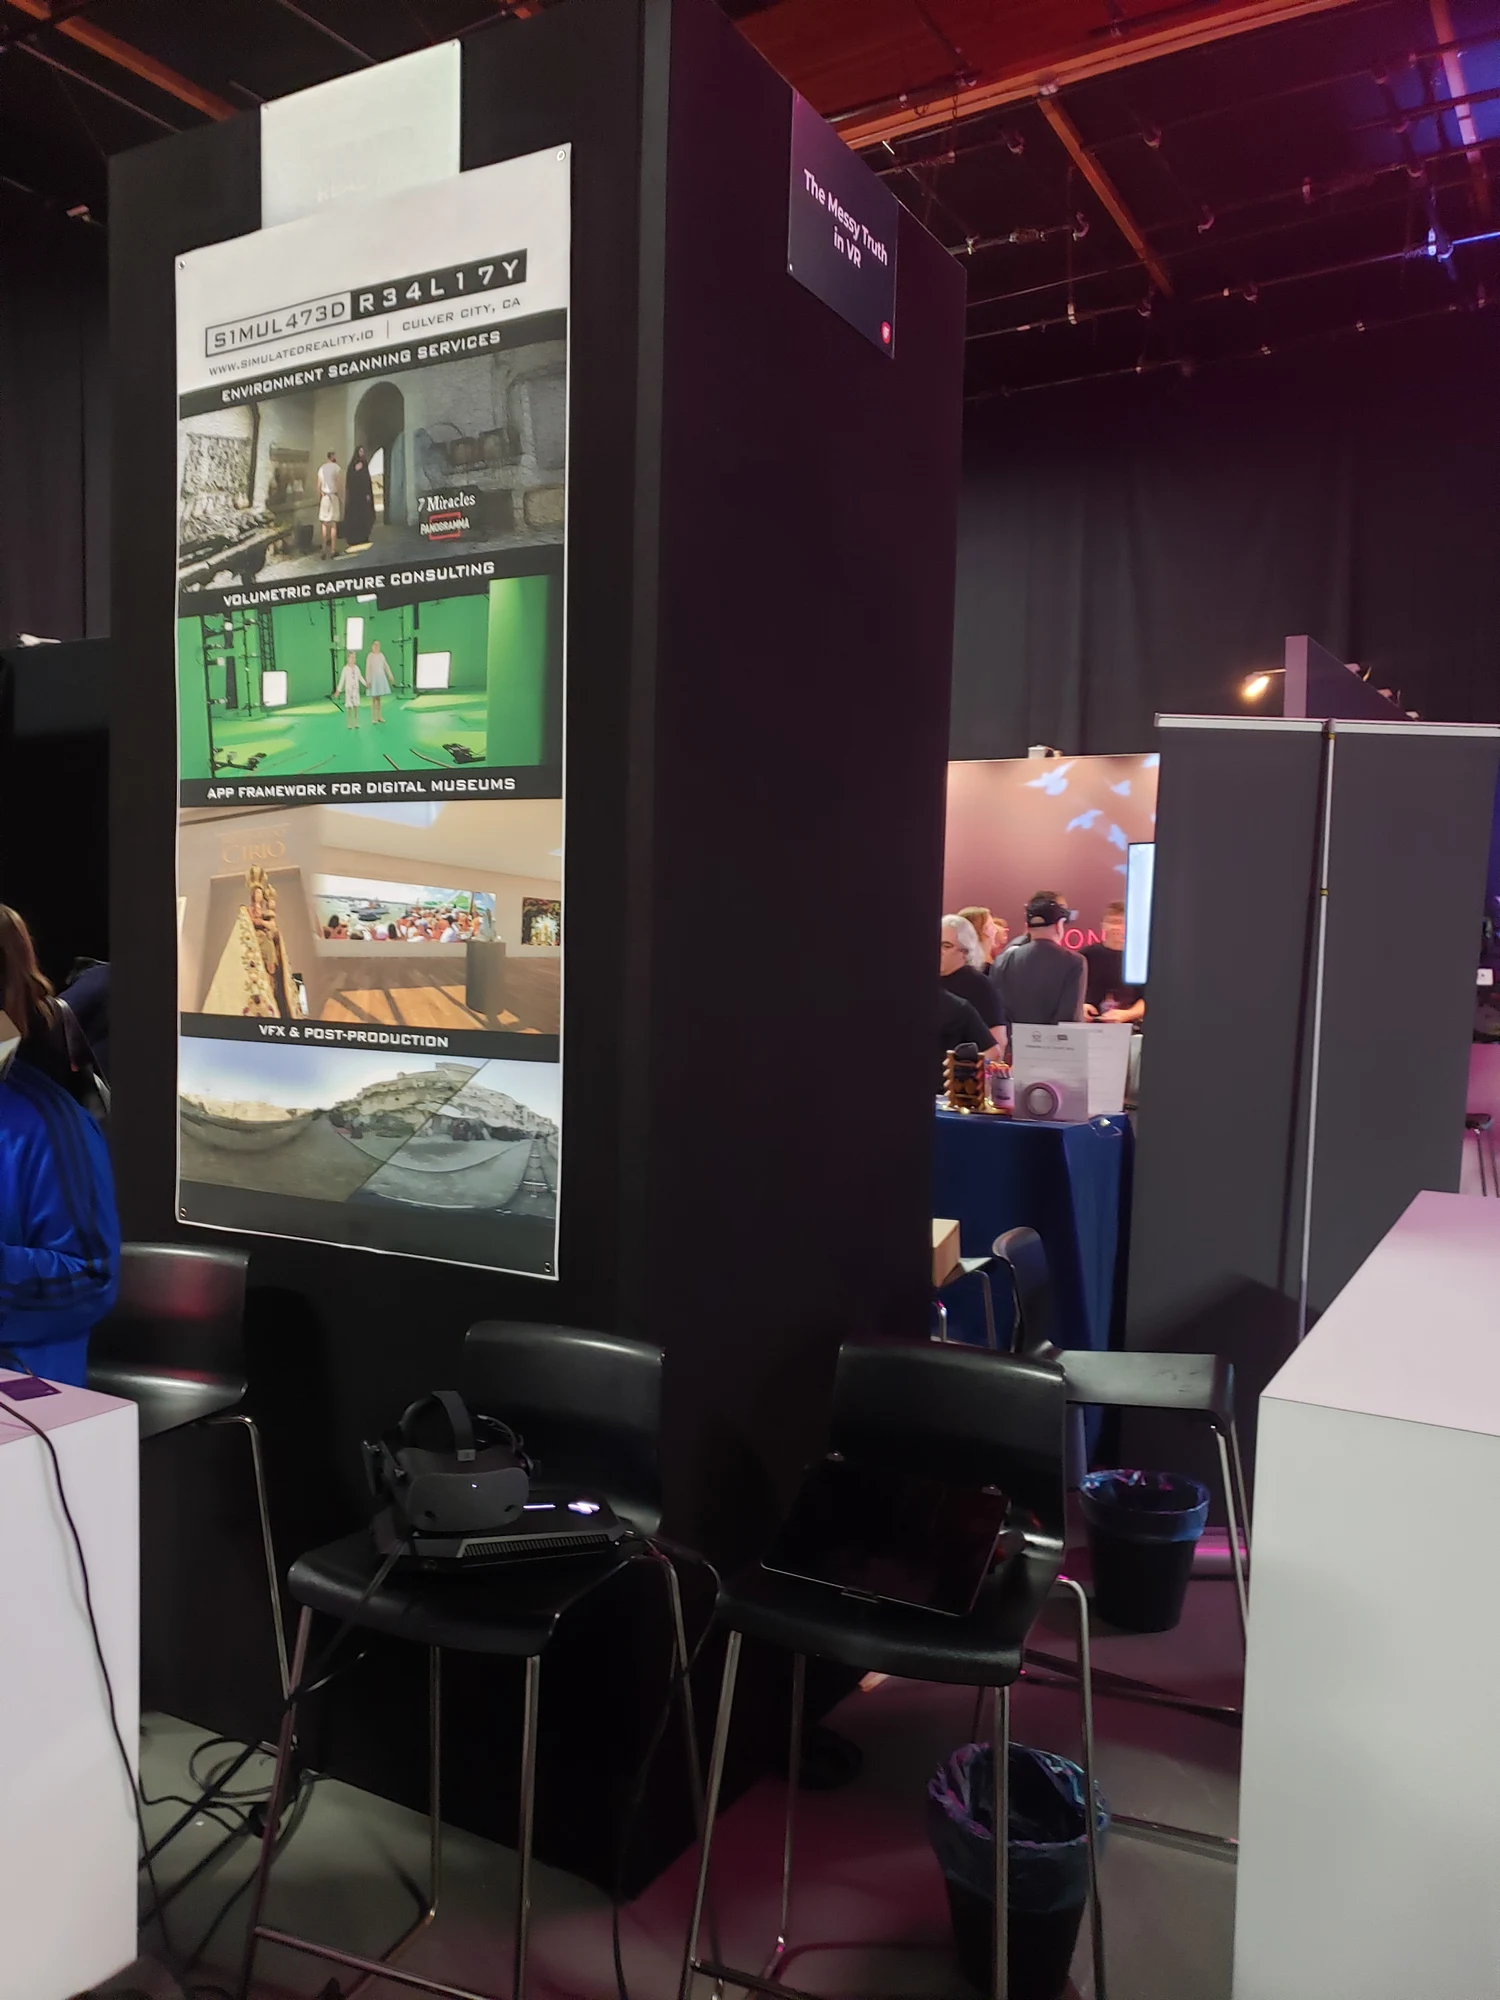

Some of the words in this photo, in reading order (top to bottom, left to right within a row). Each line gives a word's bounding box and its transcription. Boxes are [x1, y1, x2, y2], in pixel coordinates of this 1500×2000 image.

[804, 168, 826, 205] The
[828, 191, 861, 241] Messy
[861, 224, 888, 266] Truth
[833, 225, 845, 254] in
[846, 238, 862, 269] VR
[213, 301, 346, 349] S1MUL473D
[358, 258, 520, 314] R34L17Y
[208, 329, 374, 377] WWW.SIMULATEDREALITY.IO
[402, 311, 455, 331] CULVER
[460, 303, 496, 319] CITY,
[502, 297, 521, 310] CA
[221, 367, 324, 403] ENVIRONMENT
[328, 349, 412, 378] SCANNING
[417, 330, 501, 360] SERVICES
[418, 497, 426, 513] 7
[427, 491, 476, 512] Miracles
[223, 584, 311, 607] VOLUMETRIC
[315, 575, 386, 595] CAPTURE
[390, 561, 496, 585] CONSULTING
[206, 786, 235, 800] APP
[237, 783, 327, 798] FRAMEWORK
[331, 782, 362, 796] FOR
[366, 780, 427, 795] DIGITAL
[430, 777, 516, 792] MUSEUMS
[258, 1024, 286, 1038] VFX
[288, 1026, 301, 1038] &
[304, 1026, 449, 1048] POST-PRODUCTION
